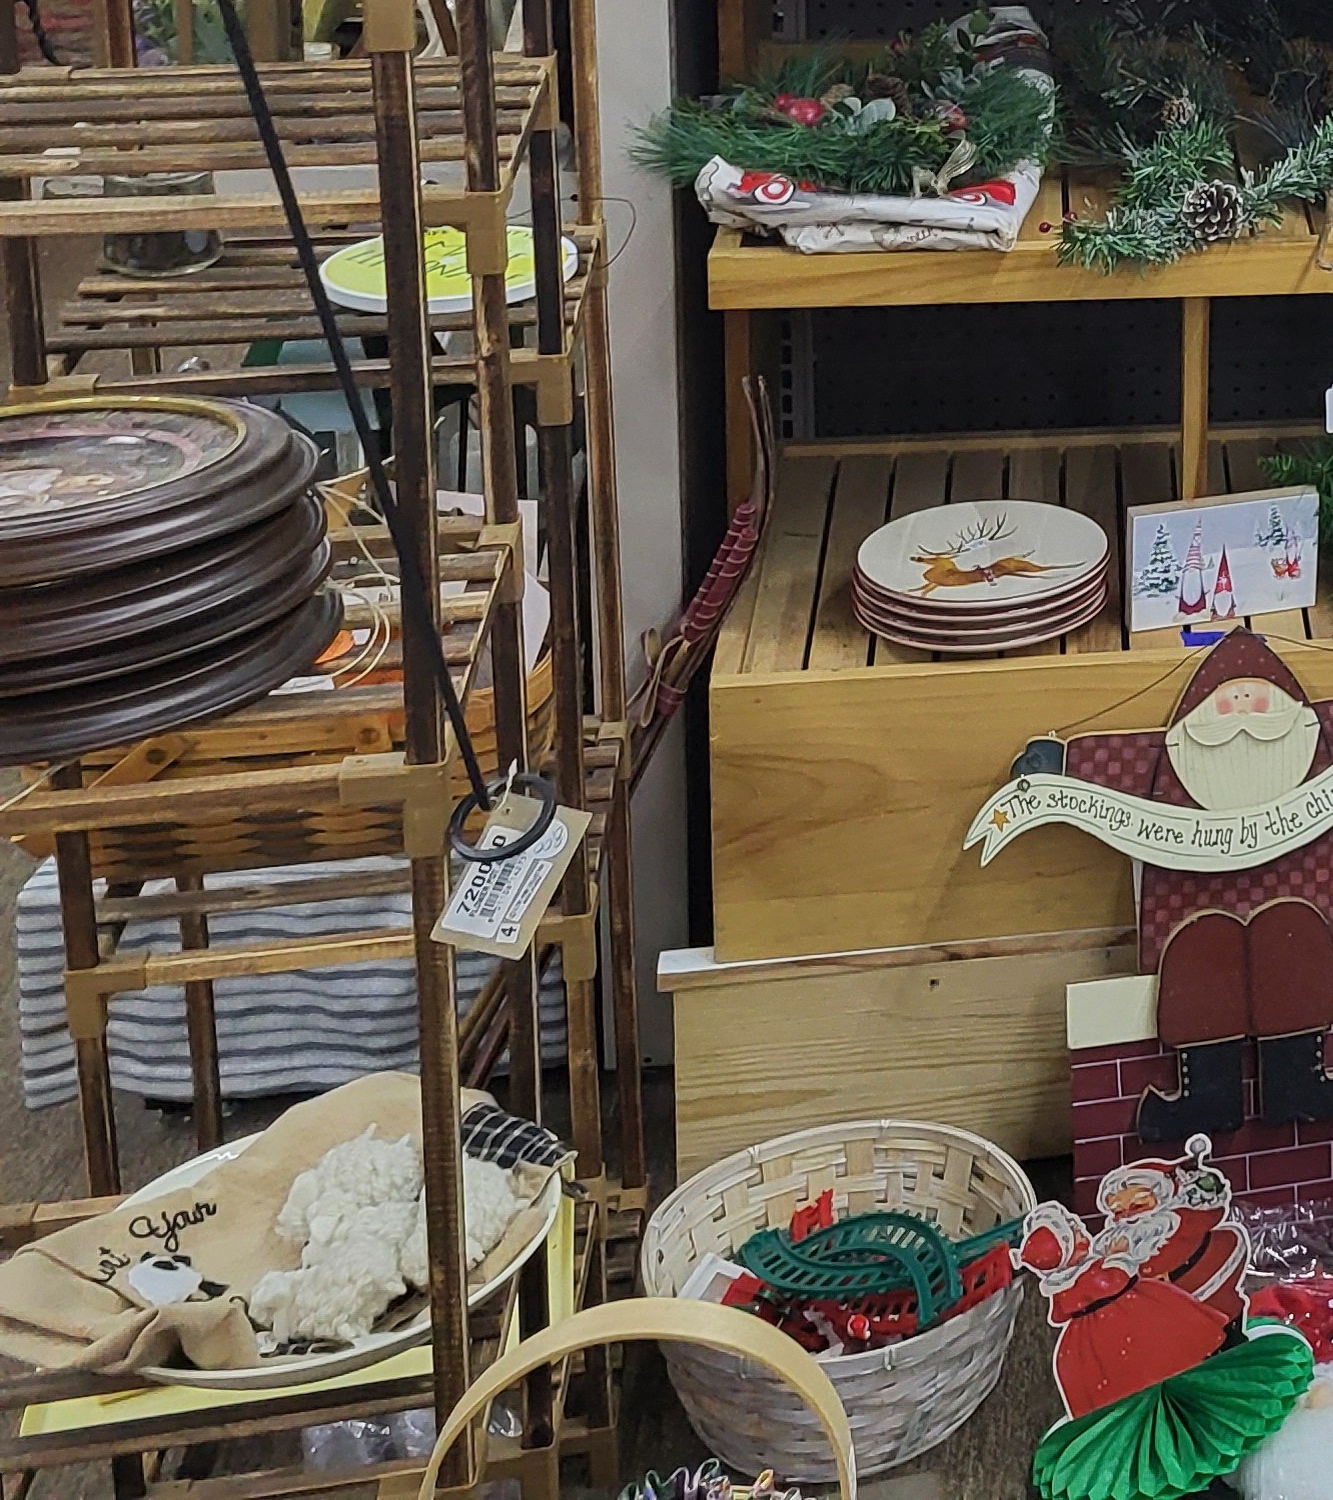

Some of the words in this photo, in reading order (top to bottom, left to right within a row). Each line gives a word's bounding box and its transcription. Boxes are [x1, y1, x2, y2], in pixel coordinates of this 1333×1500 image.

[1000, 793, 1042, 818] The
[1191, 820, 1234, 854] hung
[1239, 816, 1260, 849] by
[1264, 805, 1303, 837] the
[456, 835, 507, 915] 72000
